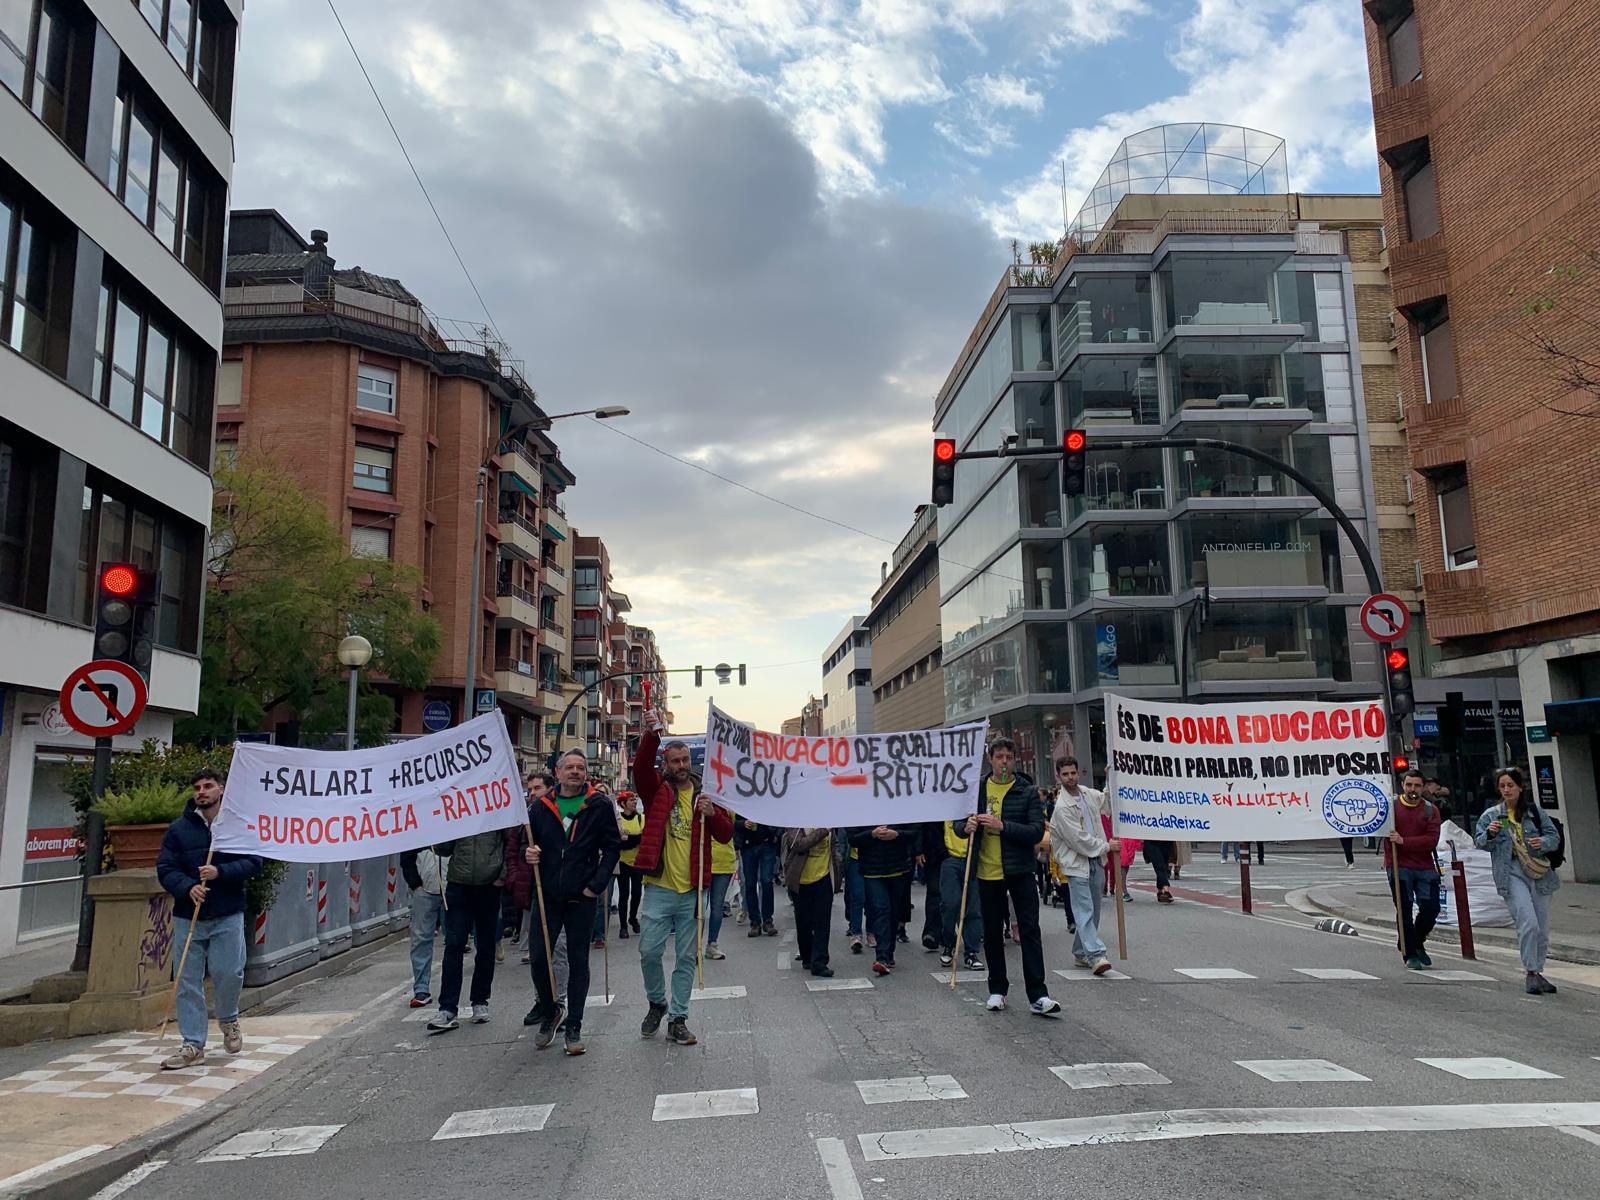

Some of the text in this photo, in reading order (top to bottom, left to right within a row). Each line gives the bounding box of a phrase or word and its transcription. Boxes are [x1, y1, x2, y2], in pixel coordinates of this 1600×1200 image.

[1201, 542, 1312, 553] ANTONIFELIP.COM
[1106, 625, 1117, 656] LAGO
[712, 711, 733, 747] PER
[732, 722, 751, 757] UNA
[854, 736, 879, 764] DE
[885, 726, 983, 764] QUALITAT
[1117, 704, 1386, 744] ÉS DE BONA EDUCACIÓ
[260, 734, 492, 797] +SALARI +RECURSOS
[736, 757, 791, 798] SOU
[1113, 749, 1172, 777] ESCOLTAR
[1174, 757, 1182, 777] I
[1185, 757, 1257, 780] PARLAR,
[1260, 756, 1289, 778] NO
[247, 777, 512, 845] -BUROCRÀCIA -RÀTIOS
[1119, 786, 1211, 805] #SOMDELARIBERA
[1212, 793, 1232, 807] EN
[1236, 792, 1301, 808] LLUITA
[1325, 782, 1352, 809] ASSEMBLEA
[1119, 812, 1210, 830] #MontcadaReixac
[1333, 820, 1345, 831] INS
[1358, 819, 1383, 833] RIBERA
